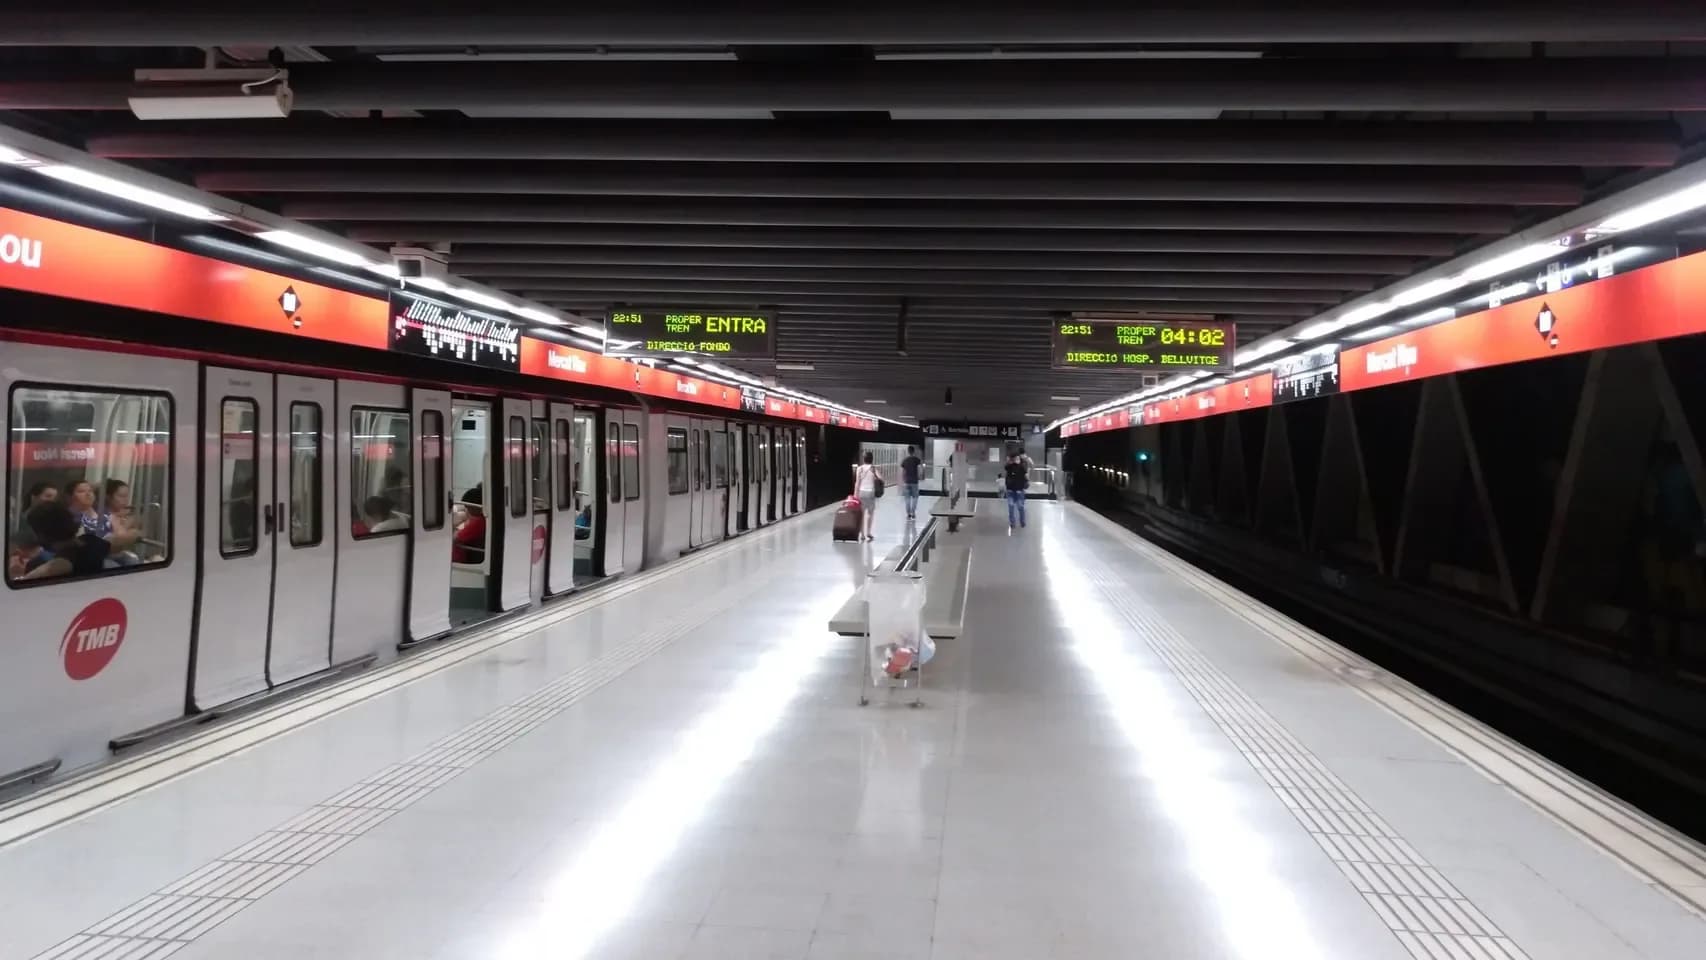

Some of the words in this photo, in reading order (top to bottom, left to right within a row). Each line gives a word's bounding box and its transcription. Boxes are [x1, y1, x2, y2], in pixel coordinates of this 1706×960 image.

[612, 313, 642, 324] 22:51
[665, 314, 702, 324] PROPER
[665, 324, 690, 333] TREN
[706, 316, 766, 333] ENTRA
[1060, 325, 1092, 335] 22:51
[1116, 326, 1156, 336] PROPER
[1117, 336, 1143, 345] TREN
[1160, 328, 1225, 346] 04:02
[1123, 354, 1154, 364] HOSP.
[1160, 355, 1219, 365] BELLVITGE
[76, 623, 120, 653] TMB
